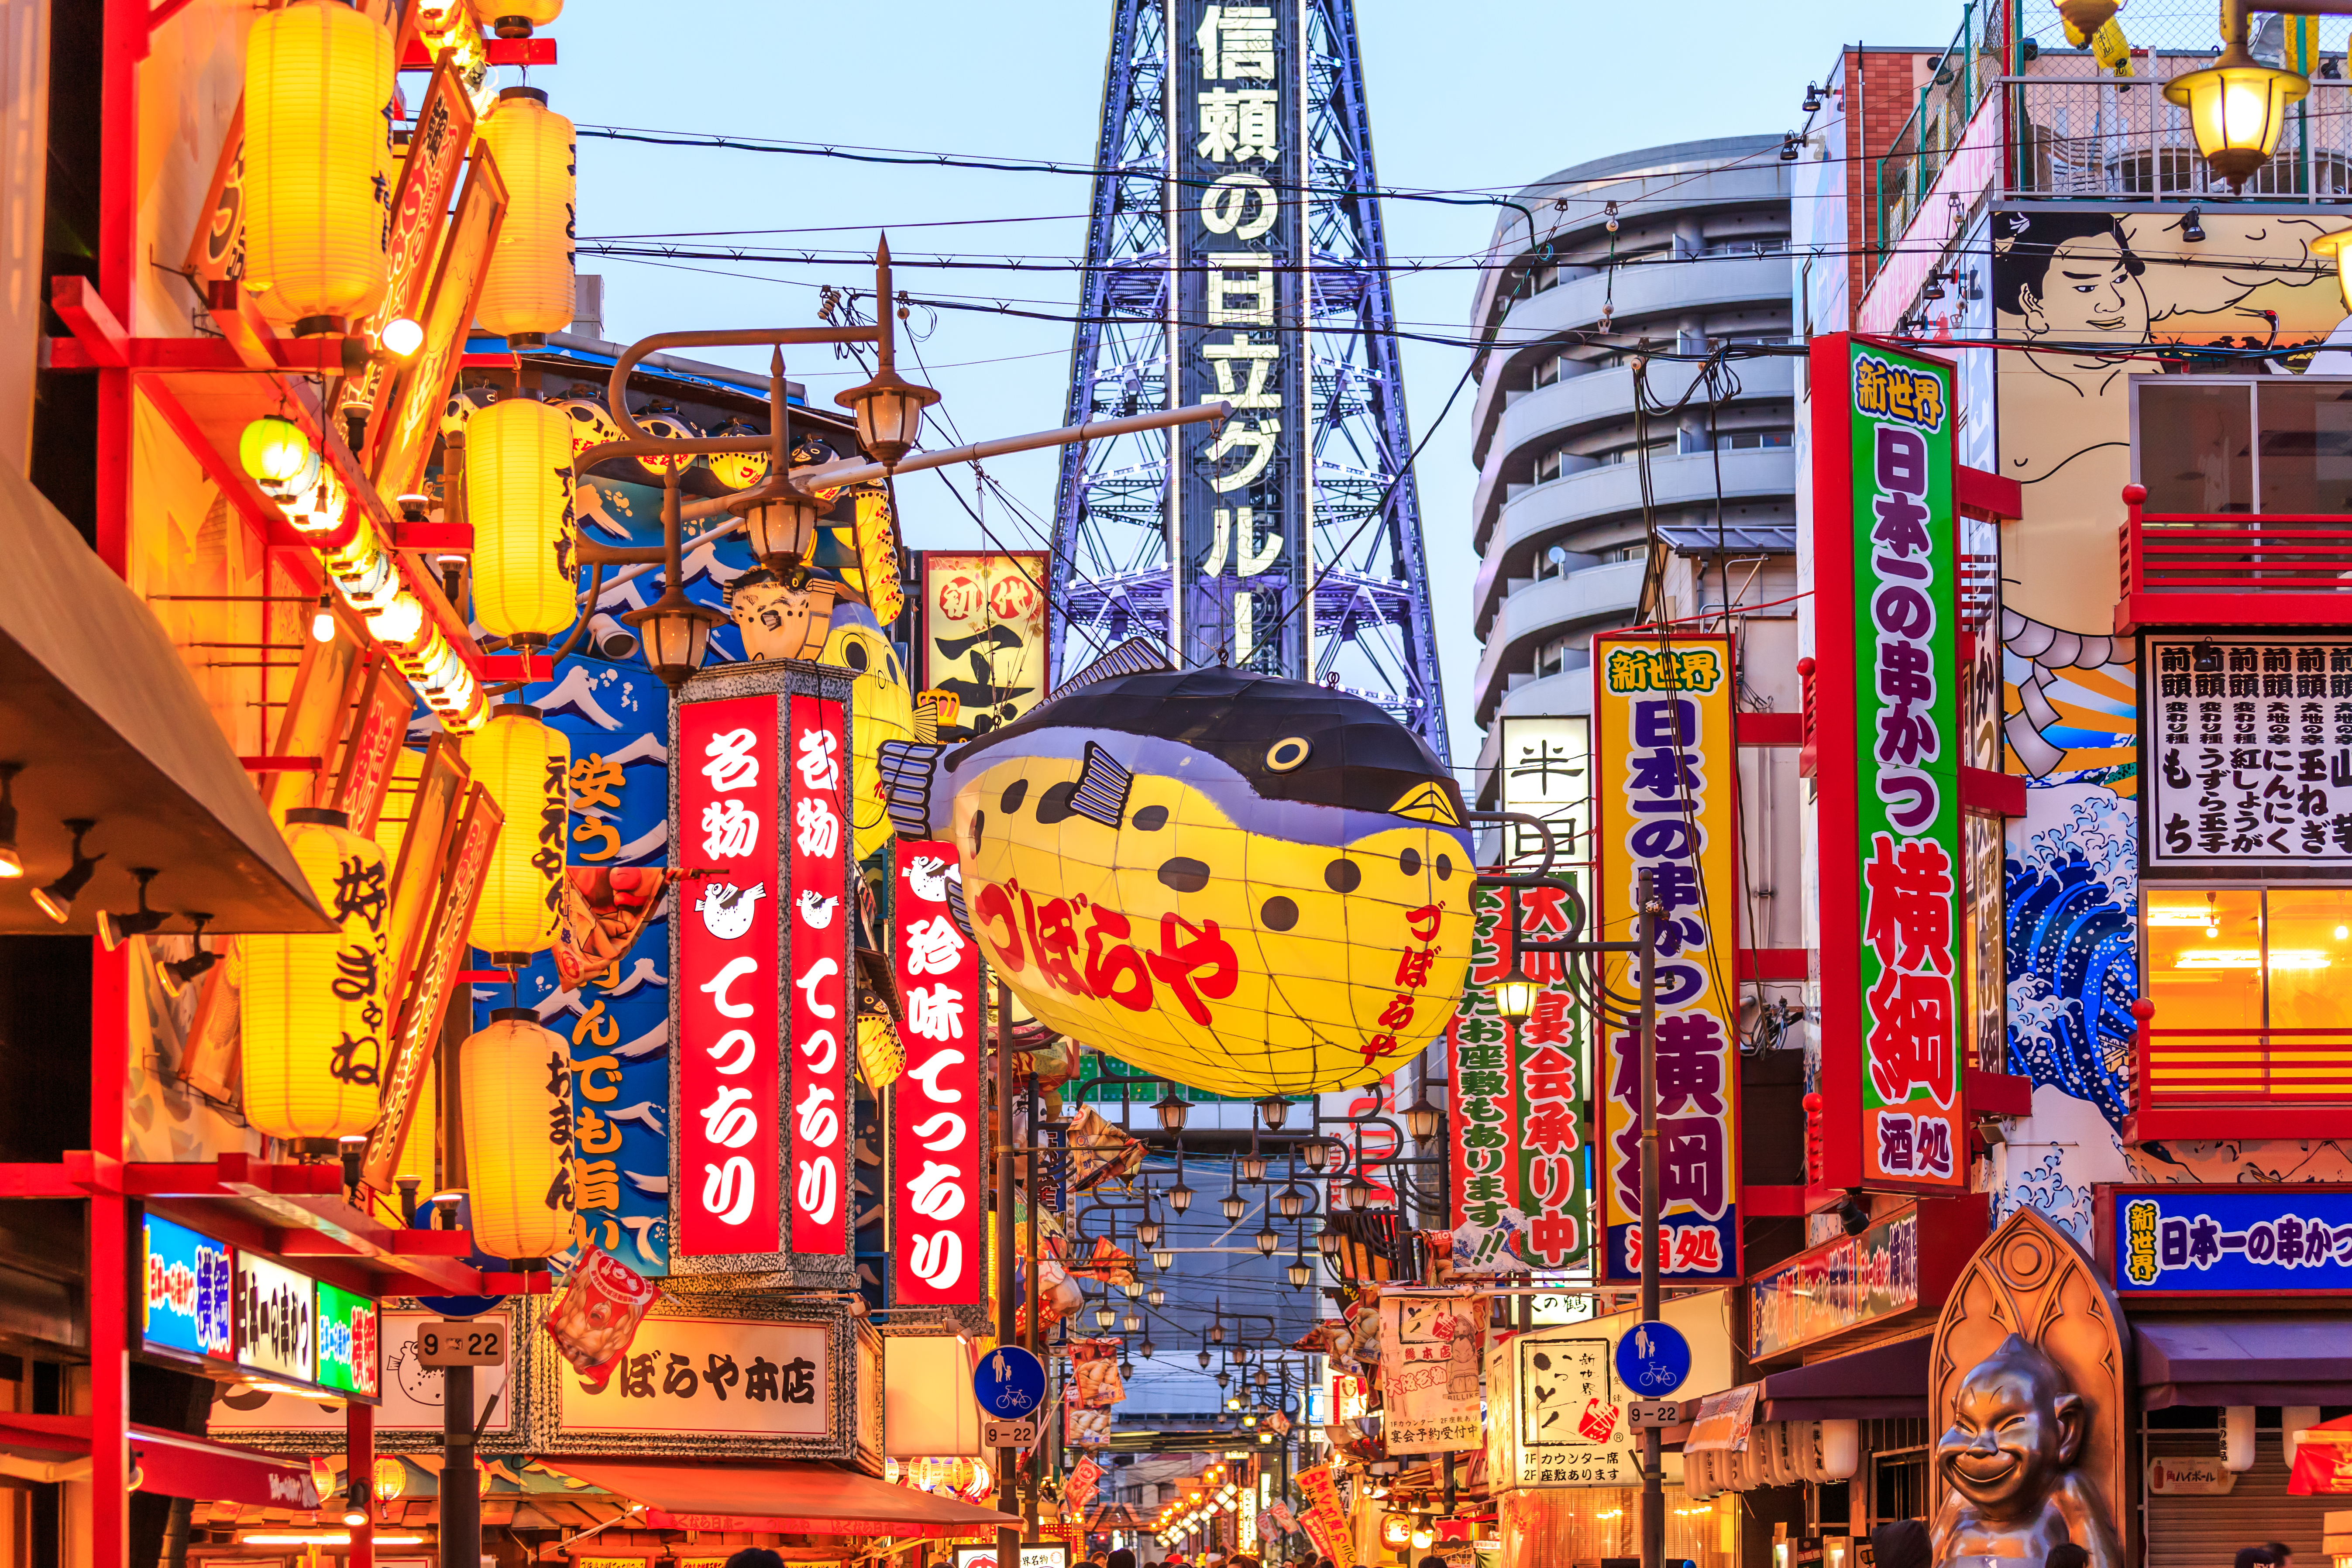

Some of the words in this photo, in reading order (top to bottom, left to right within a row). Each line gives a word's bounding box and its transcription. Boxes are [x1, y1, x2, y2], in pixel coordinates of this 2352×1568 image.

[1196, 5, 1283, 663] 信頼の日立グルー
[1858, 359, 1942, 429] 新世界
[1874, 427, 1938, 826] 日本一の串かつ
[1611, 652, 1718, 691] 新世界
[2160, 647, 2192, 698] 前頭
[2228, 647, 2259, 698] 前頭
[2262, 647, 2293, 698] 前頭
[2296, 647, 2327, 698] 前頭
[2330, 647, 2352, 698] 前頭
[701, 728, 760, 861] 名物
[796, 728, 839, 860] 名物
[2163, 748, 2192, 853] もち
[2196, 748, 2231, 853] うずら玉子
[2229, 748, 2263, 853] 紅しょうが
[2263, 748, 2295, 853] にんにく
[2297, 748, 2331, 853] 玉ねぎ
[1629, 699, 1705, 1005] 日本一の串かつ
[975, 877, 1239, 1027] づぼらや
[1360, 900, 1446, 1066] づぼらや
[1867, 836, 1953, 1107] 横綱
[570, 753, 627, 1250] 安うんでも旨い
[699, 956, 758, 1224] てっちり
[796, 956, 839, 1225] てっちり
[906, 919, 966, 1289] 珍味てっちり
[1614, 1013, 1724, 1217] 横綱
[1881, 1116, 1951, 1173] 酒処
[2131, 1204, 2157, 1281] 新世界
[2162, 1218, 2352, 1266] 日本一の串かつ
[150, 1254, 195, 1316] 日本一の串かつ
[195, 1245, 230, 1353] 横綱
[238, 1269, 307, 1368] 日本一の串かつ
[319, 1315, 351, 1365] 日本一の串かつ
[351, 1305, 378, 1393] 横綱
[578, 1349, 815, 1404] ぼらや本店
[1385, 1366, 1448, 1398] 大阪名物
[1579, 1353, 1600, 1396] 新世界
[989, 1428, 1032, 1442] 9-22
[1390, 1424, 1479, 1444] 宴会予約受付中
[1525, 1454, 1536, 1465] 1F
[1541, 1452, 1619, 1465] カウンター席
[1632, 1408, 1676, 1421] 9-22
[1524, 1470, 1536, 1481] 2F
[1541, 1468, 1619, 1481] 座敷あります
[2166, 1471, 2216, 1482] 角ハイボール
[1021, 1554, 1048, 1566] 界名物
